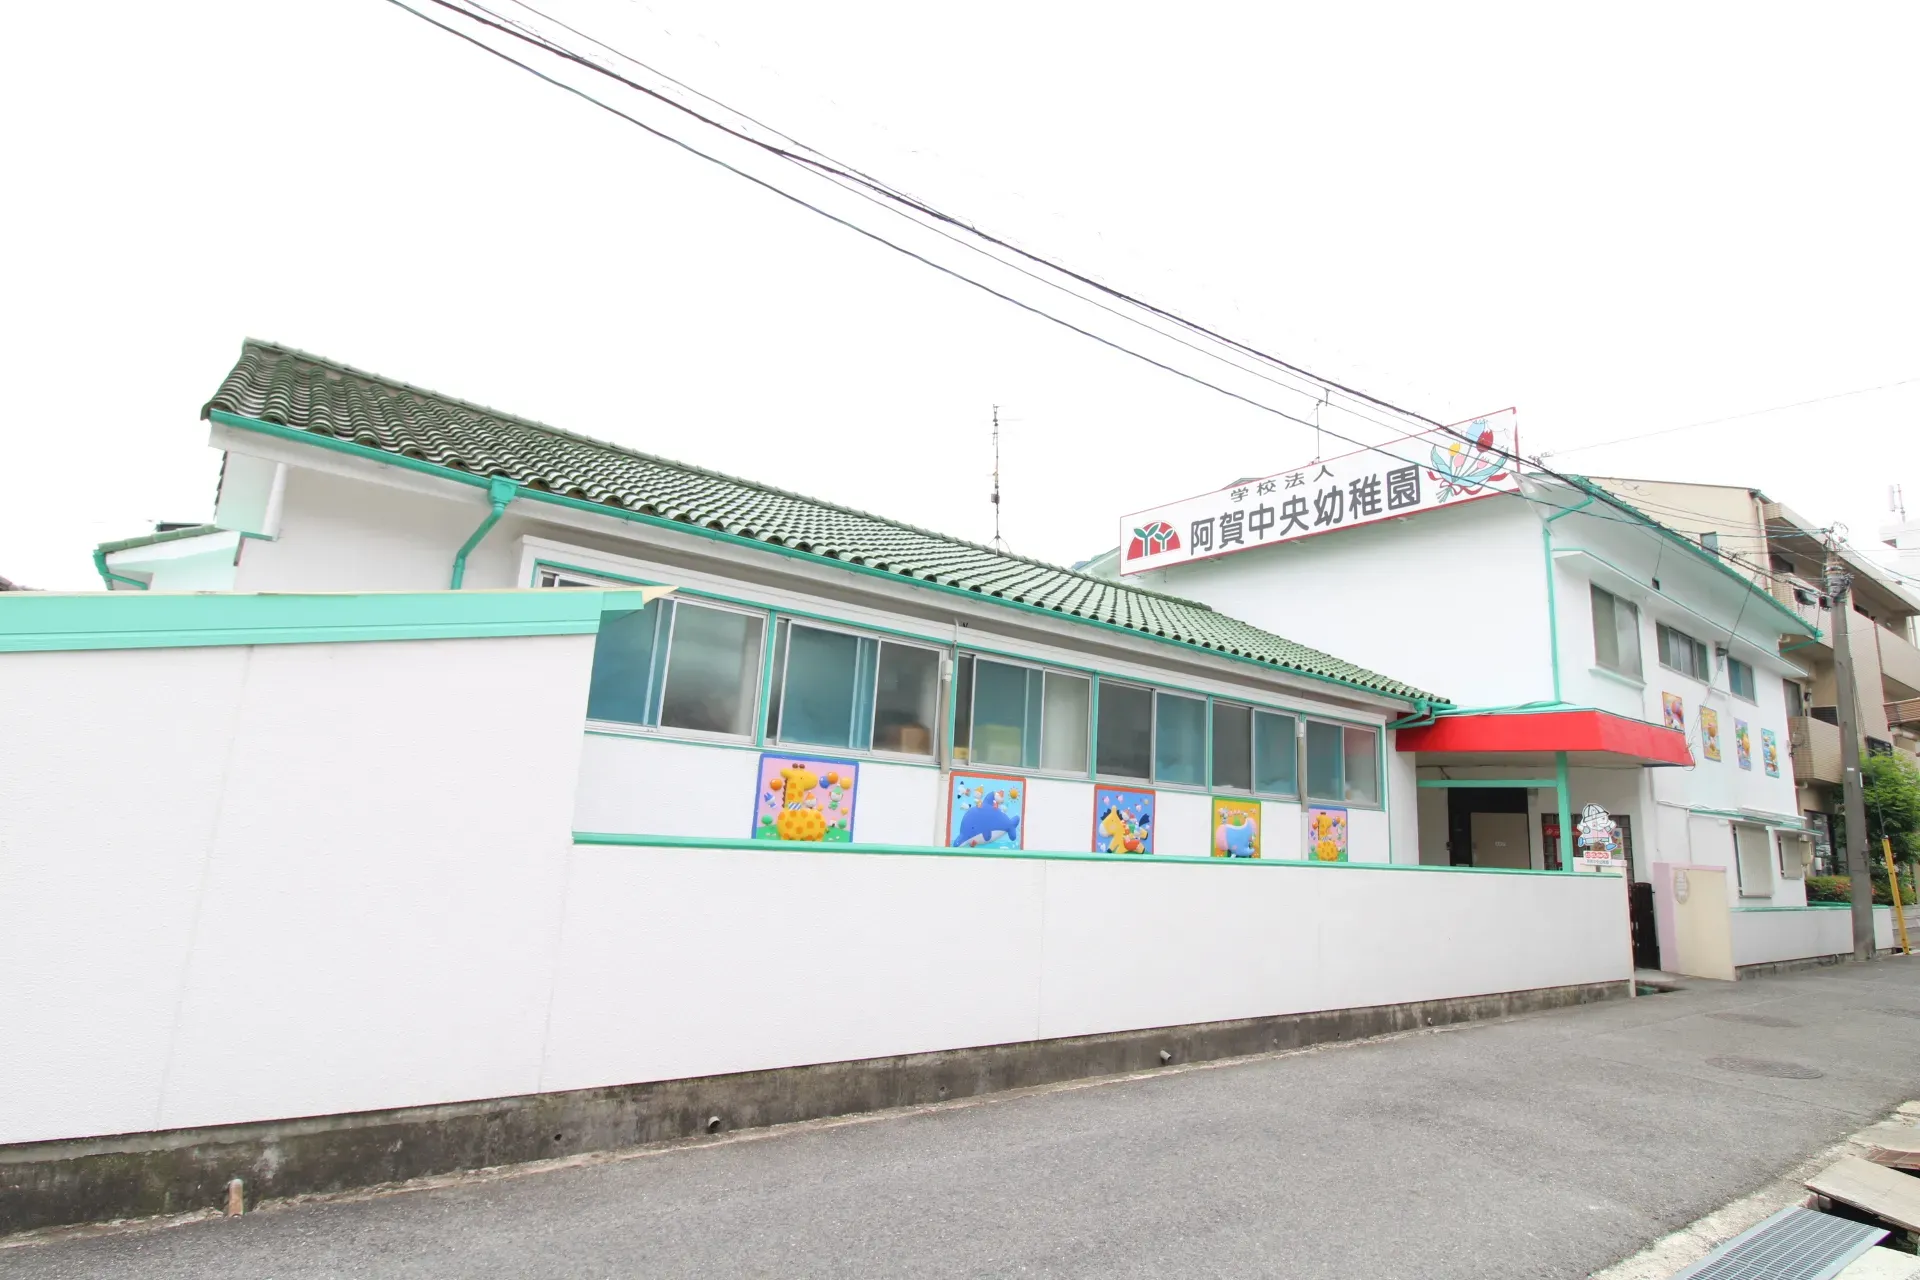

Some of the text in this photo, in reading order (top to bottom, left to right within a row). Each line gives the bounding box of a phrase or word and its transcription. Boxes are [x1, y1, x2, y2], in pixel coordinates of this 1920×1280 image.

[1190, 464, 1421, 555] 阿賀中央幼稚園
[1230, 464, 1334, 503] 学校法人
